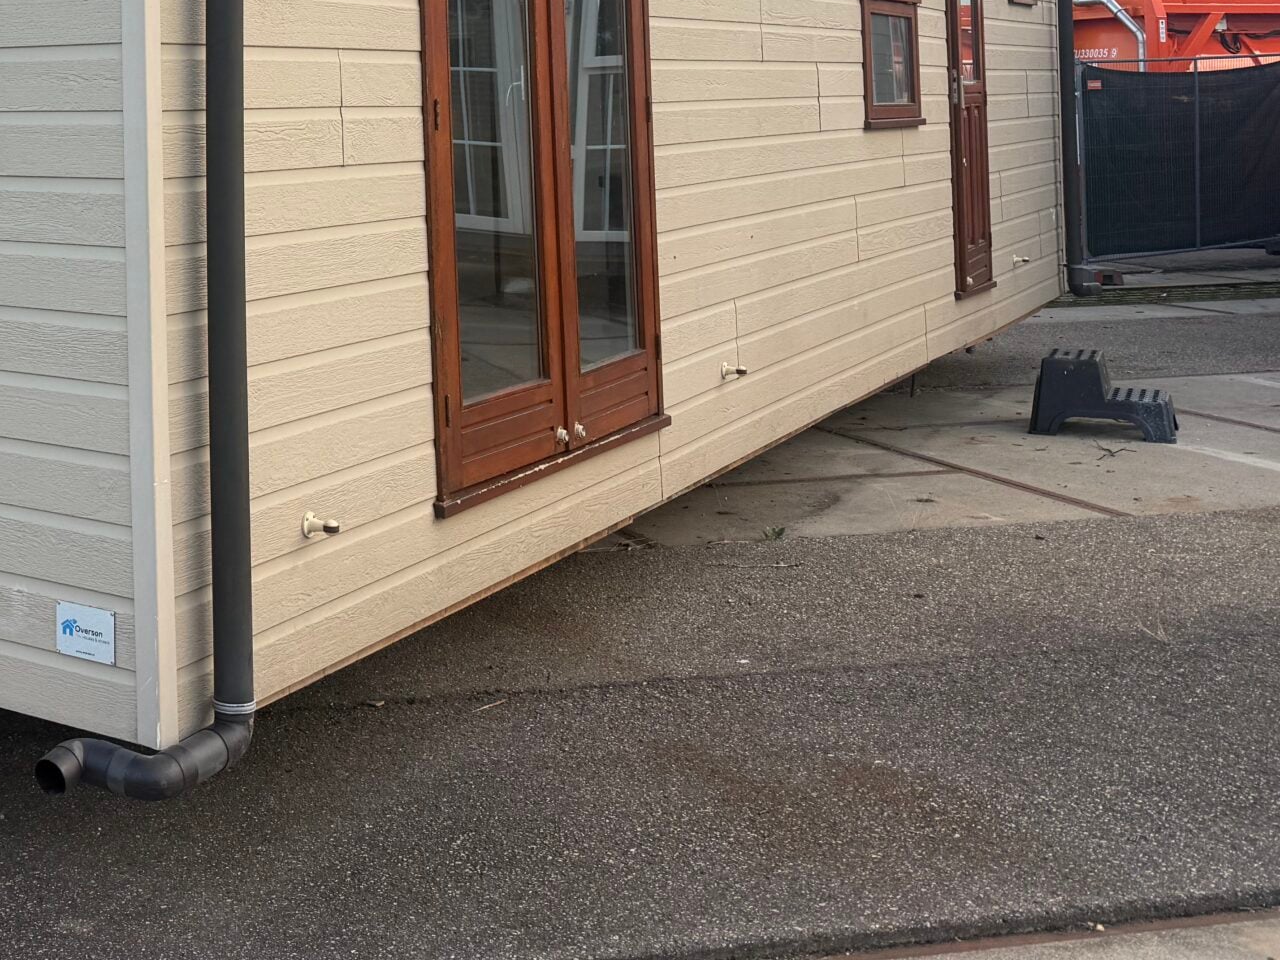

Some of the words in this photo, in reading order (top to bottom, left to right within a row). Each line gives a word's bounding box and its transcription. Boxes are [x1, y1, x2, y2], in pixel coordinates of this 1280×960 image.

[1073, 48, 1109, 59] U330035
[1111, 47, 1118, 58] 9
[74, 624, 103, 638] Overson
